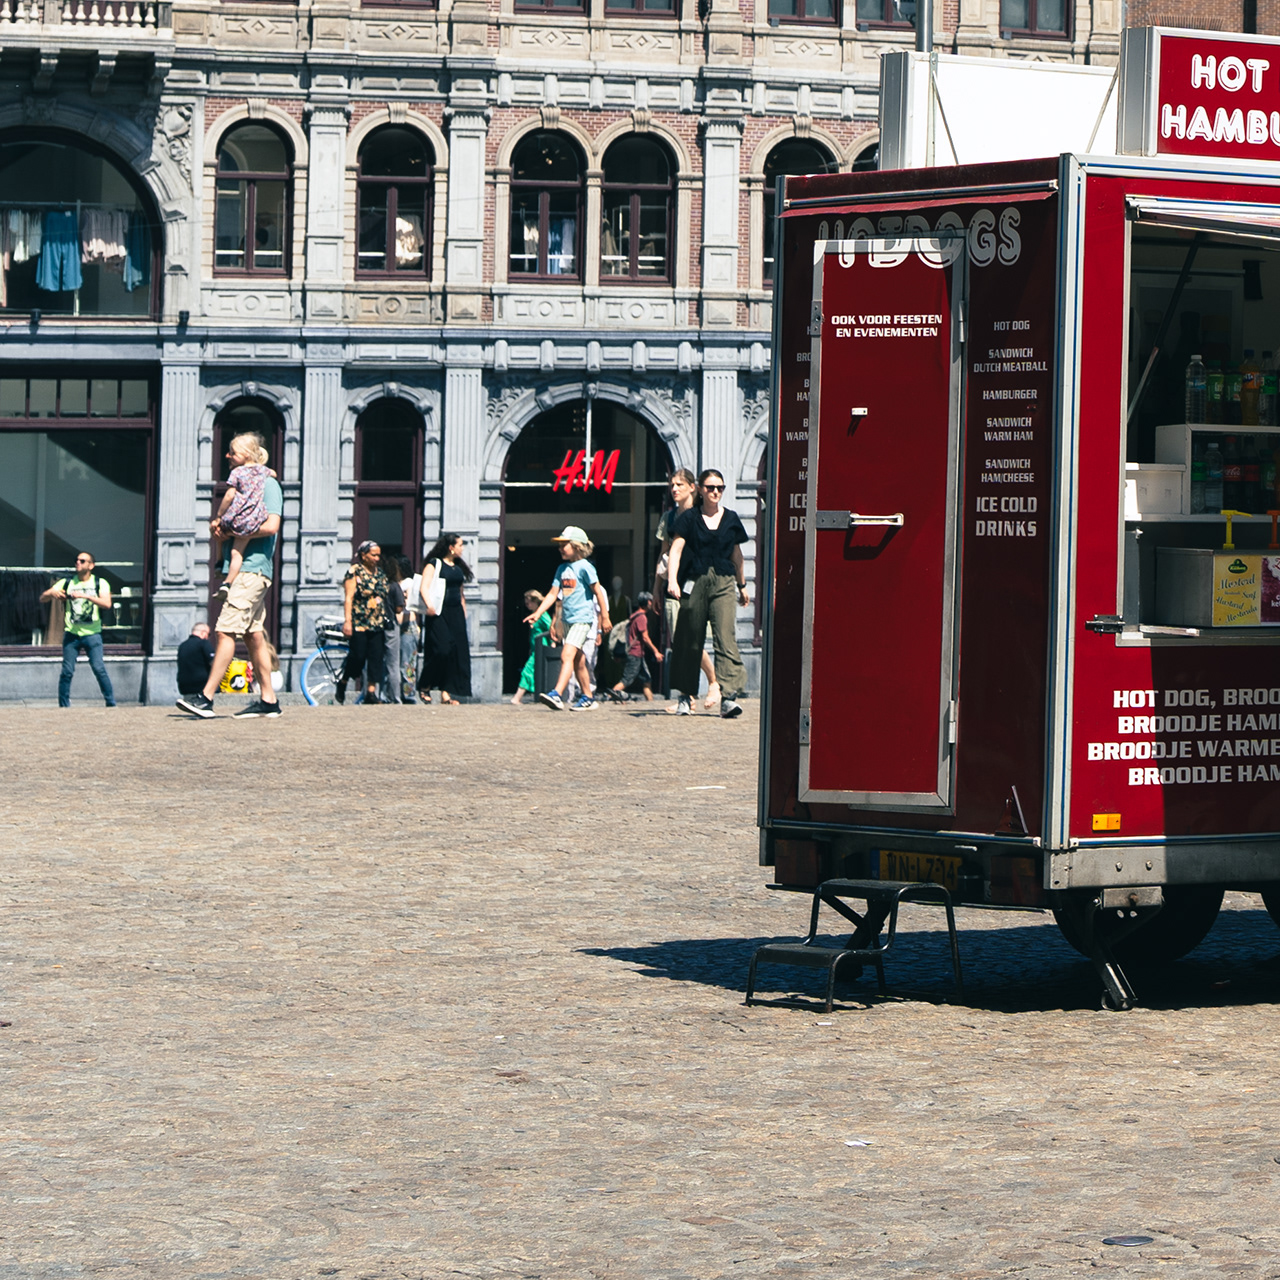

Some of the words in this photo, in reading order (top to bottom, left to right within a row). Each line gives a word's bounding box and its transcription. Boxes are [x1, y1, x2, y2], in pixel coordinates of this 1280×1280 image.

[1190, 53, 1270, 93] HOT
[831, 315, 856, 325] OOK
[859, 315, 891, 324] VOOR
[893, 314, 943, 324] FEESTEN
[993, 321, 1010, 331] HOT
[1012, 320, 1030, 330] DOG
[836, 328, 851, 337] EN
[854, 327, 938, 337] EVENEMENTEN
[988, 348, 1033, 359] SANDWICH
[973, 362, 1001, 373] DUTCH
[1002, 361, 1048, 372] MEATBALL
[982, 389, 1037, 400] HAMBURGER
[986, 417, 1032, 428] SANDWICH
[984, 431, 1012, 441] WARM
[1013, 431, 1034, 440] HAM
[985, 458, 1031, 469] SANDWICH
[551, 449, 621, 494] H&M
[981, 472, 1035, 483] HAM/CHEESE
[976, 496, 998, 513] ICE
[1000, 496, 1038, 513] COLD
[975, 520, 1037, 537] DRINKS
[1113, 689, 1158, 708] HOT
[1163, 688, 1217, 709] DOG,
[1118, 714, 1222, 734] BROODJE
[1087, 740, 1193, 761] BROODJE
[1128, 765, 1233, 786] BROODJE
